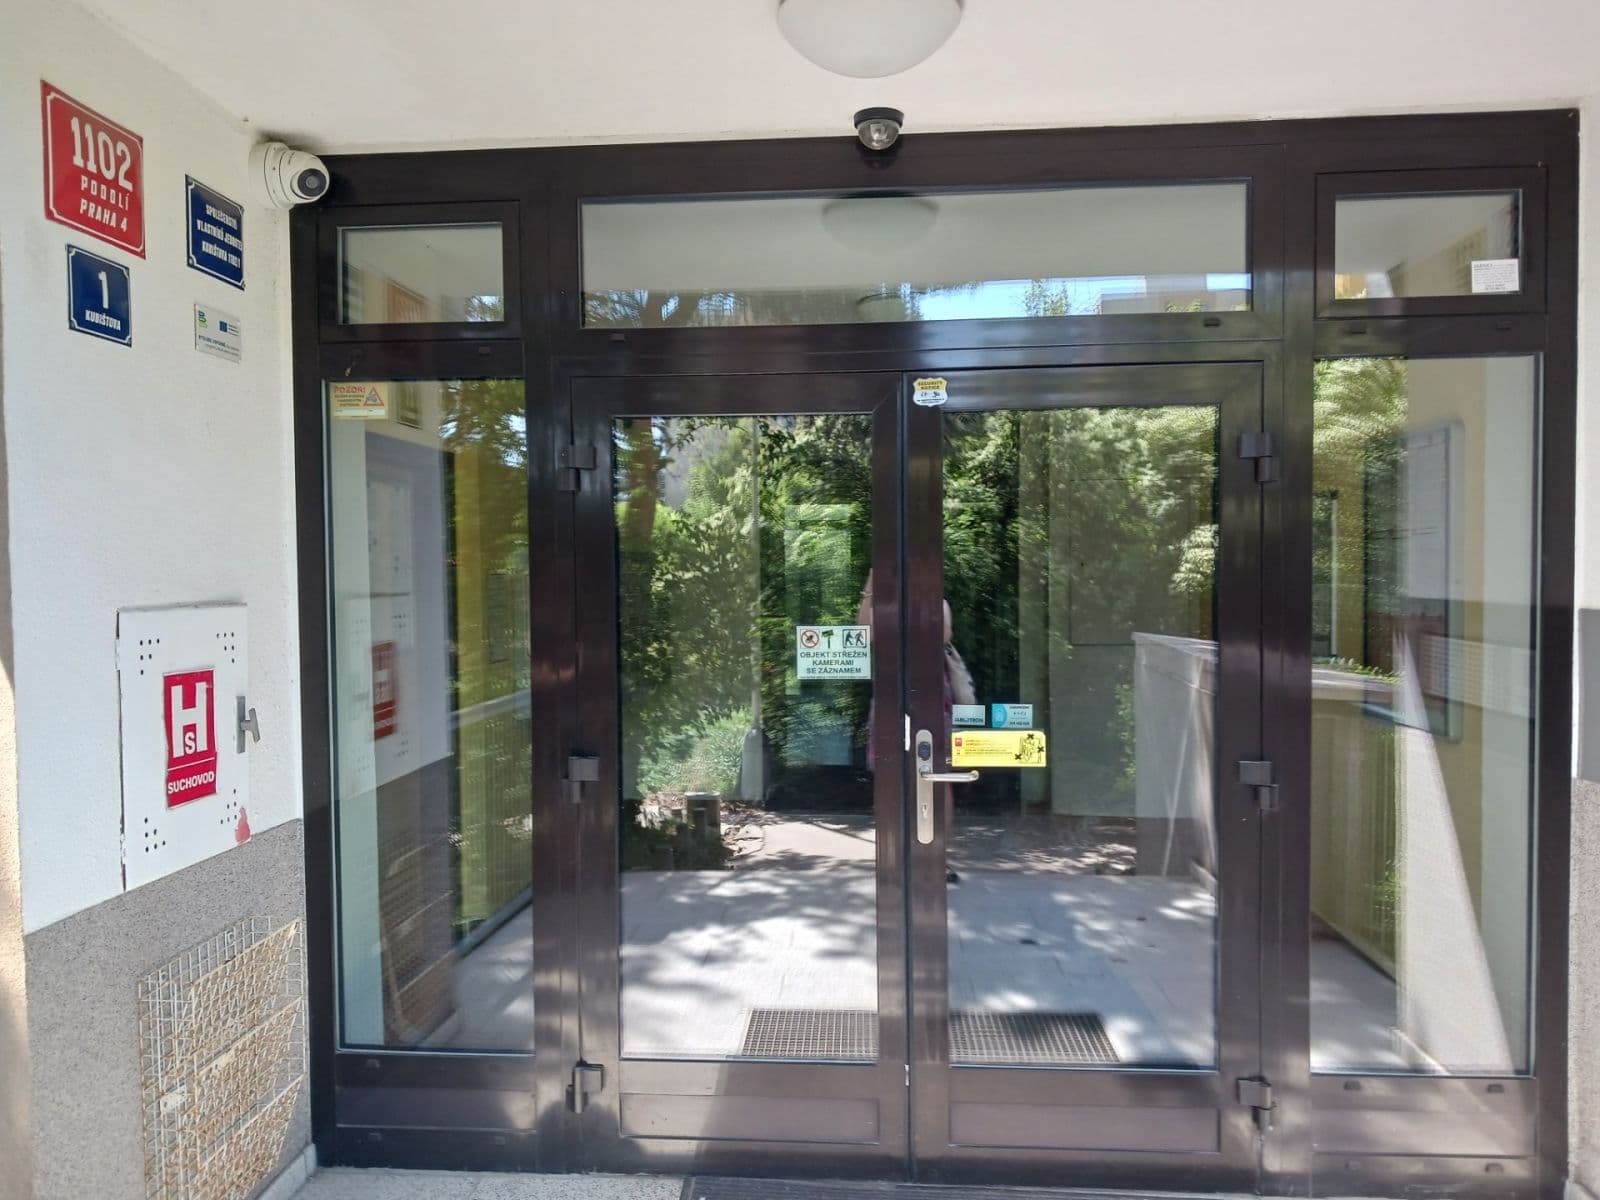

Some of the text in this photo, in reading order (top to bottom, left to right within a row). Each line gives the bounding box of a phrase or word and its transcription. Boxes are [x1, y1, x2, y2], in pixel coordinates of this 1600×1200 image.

[71, 116, 133, 192] 1102
[81, 175, 129, 211] PODOLÍ
[80, 198, 128, 233] PRAHA 4
[98, 270, 109, 309] 1
[85, 309, 121, 331] KUBIŠTOVA
[832, 650, 867, 658] STŘEŽEN
[818, 666, 861, 674] ZÁZNAMEM
[168, 771, 215, 794] SUCHOVOD
